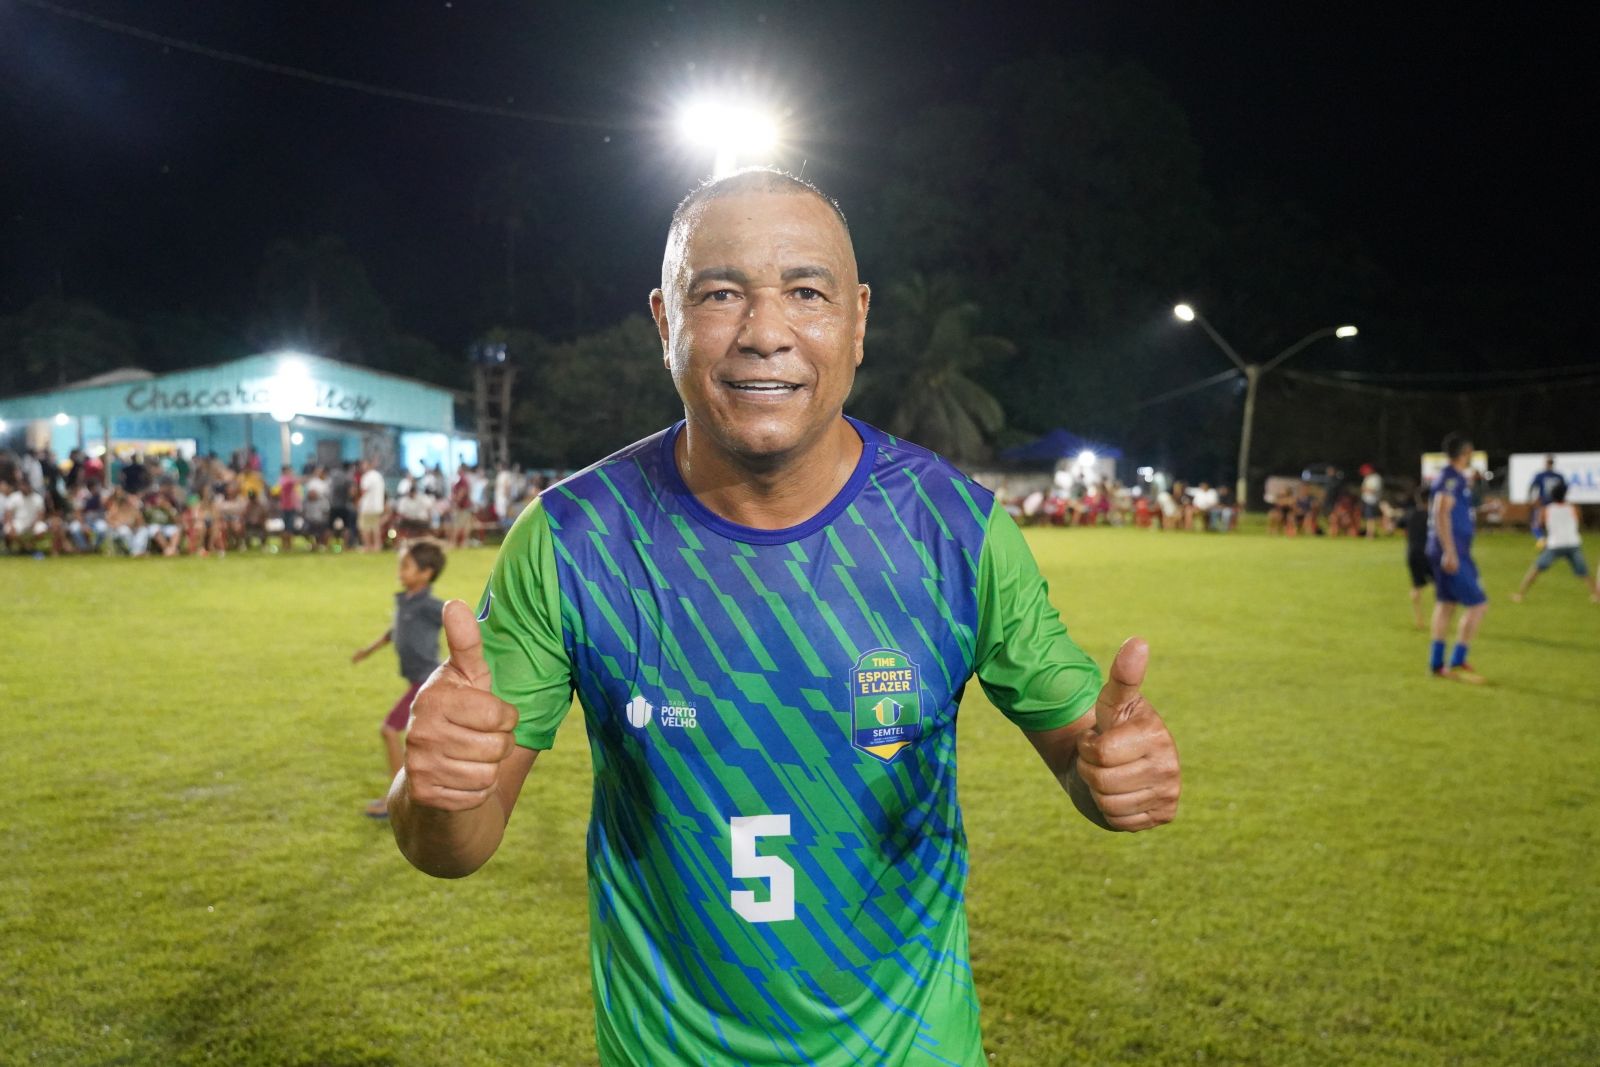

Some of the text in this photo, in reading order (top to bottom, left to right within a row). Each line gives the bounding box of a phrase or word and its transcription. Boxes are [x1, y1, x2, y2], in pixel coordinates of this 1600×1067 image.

[872, 657, 896, 667] TIME
[858, 670, 912, 683] ESPORTE
[862, 681, 910, 694] E LAZER
[661, 706, 697, 718] PORTO
[661, 717, 697, 729] VELHO
[873, 727, 904, 738] SEMTEL
[730, 814, 795, 924] 5
